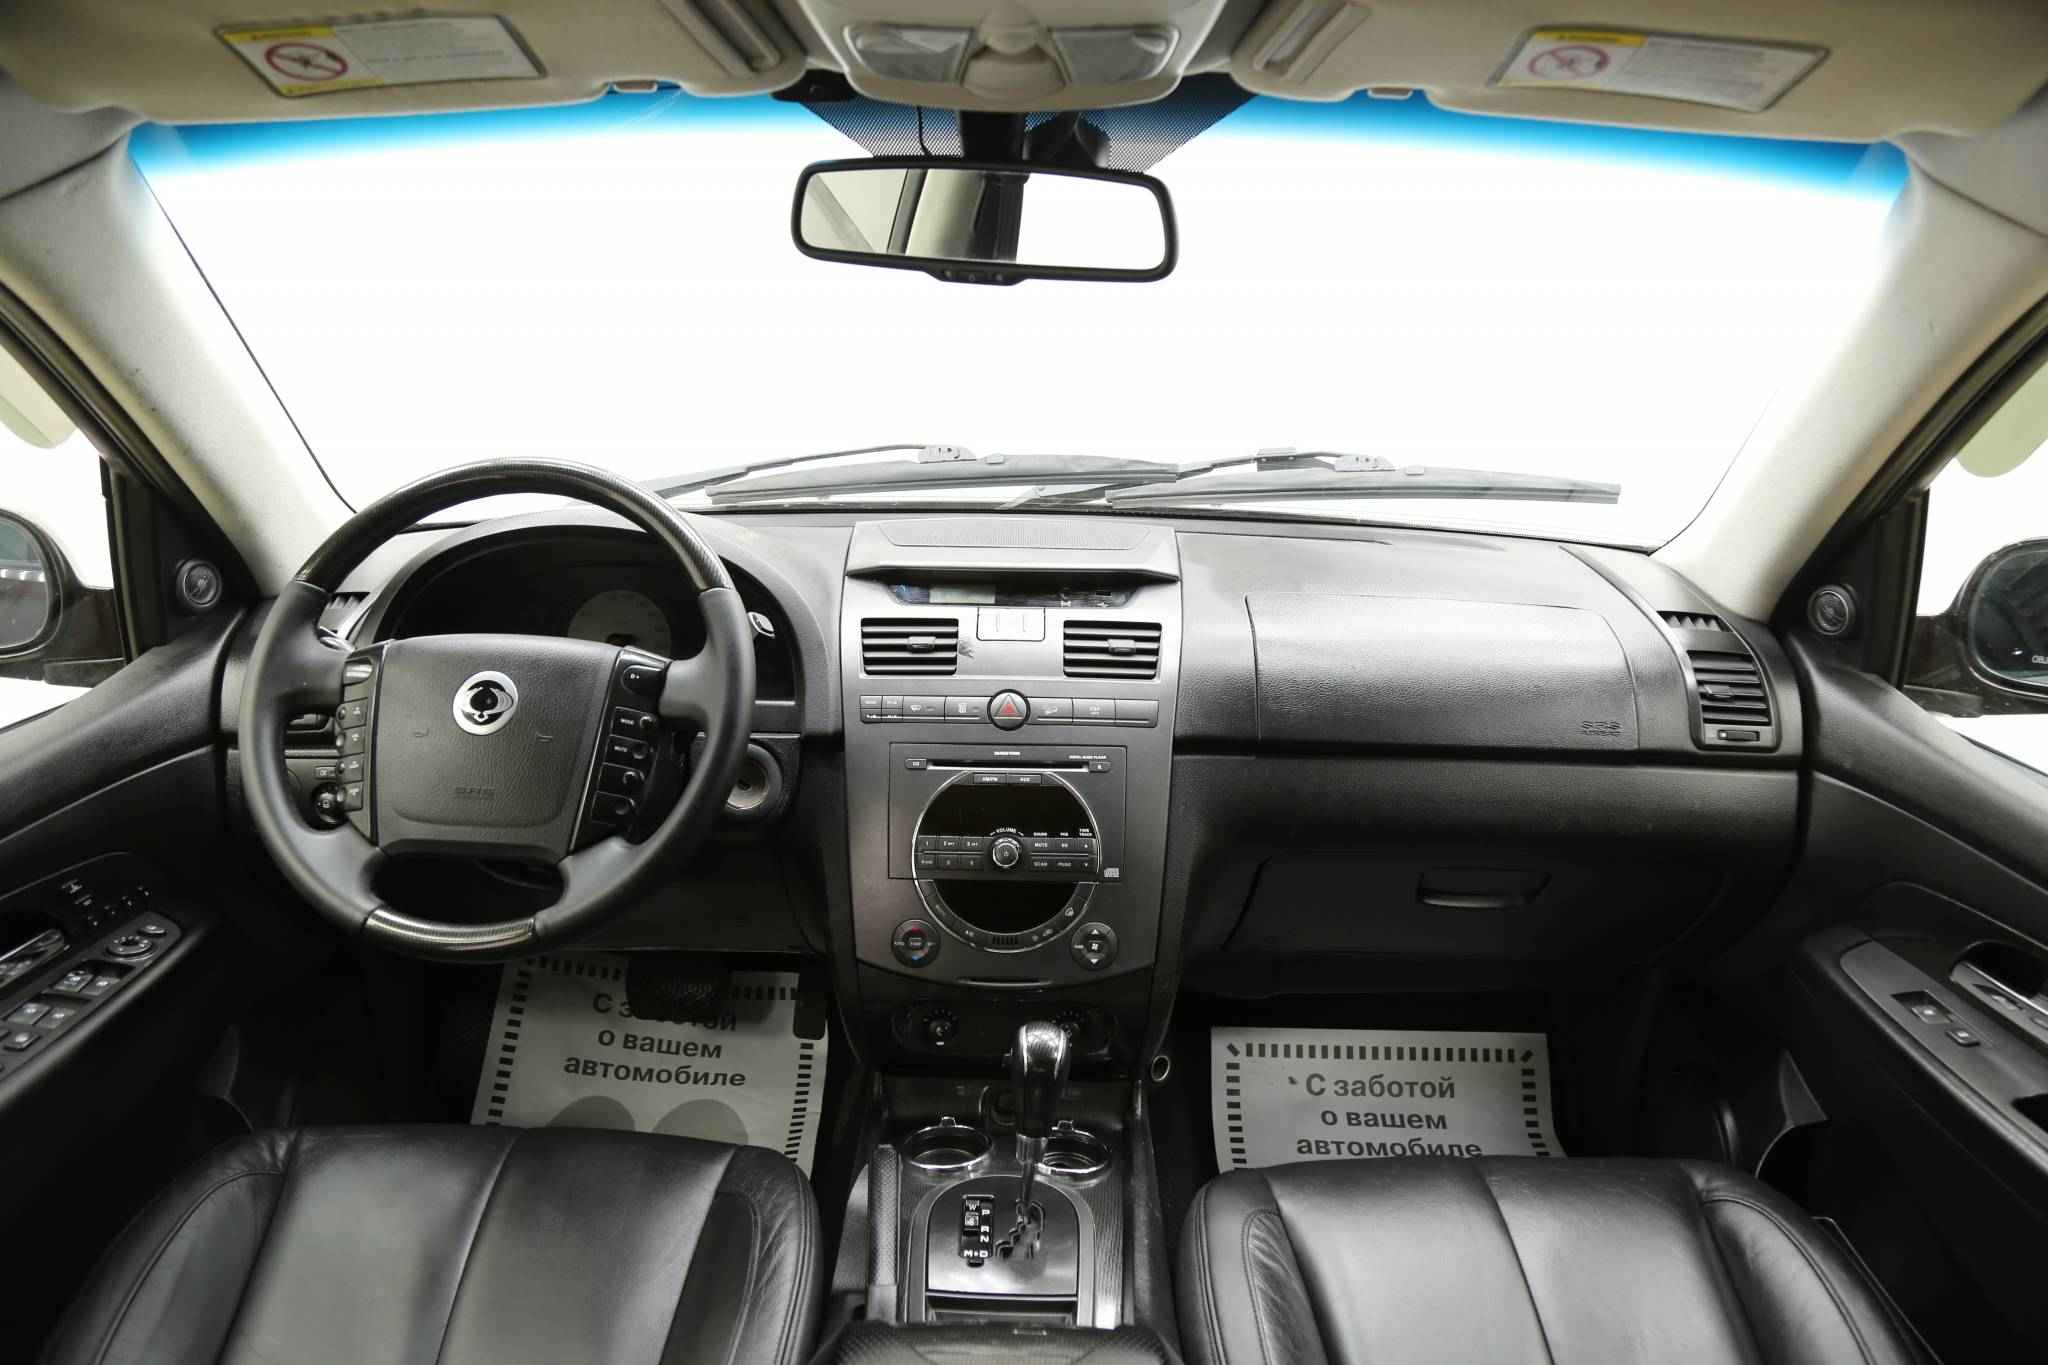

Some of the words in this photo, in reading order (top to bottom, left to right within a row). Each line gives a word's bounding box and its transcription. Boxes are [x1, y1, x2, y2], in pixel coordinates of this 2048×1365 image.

[598, 1030, 615, 1046] о
[622, 1033, 722, 1058] вашем
[563, 1056, 746, 1086] автомобиле
[1306, 1073, 1326, 1097] С
[1334, 1074, 1456, 1099] заботой
[1321, 1110, 1338, 1126] о
[1346, 1111, 1447, 1130] вашем
[1297, 1137, 1482, 1158] автомобиле
[980, 1235, 990, 1243] N
